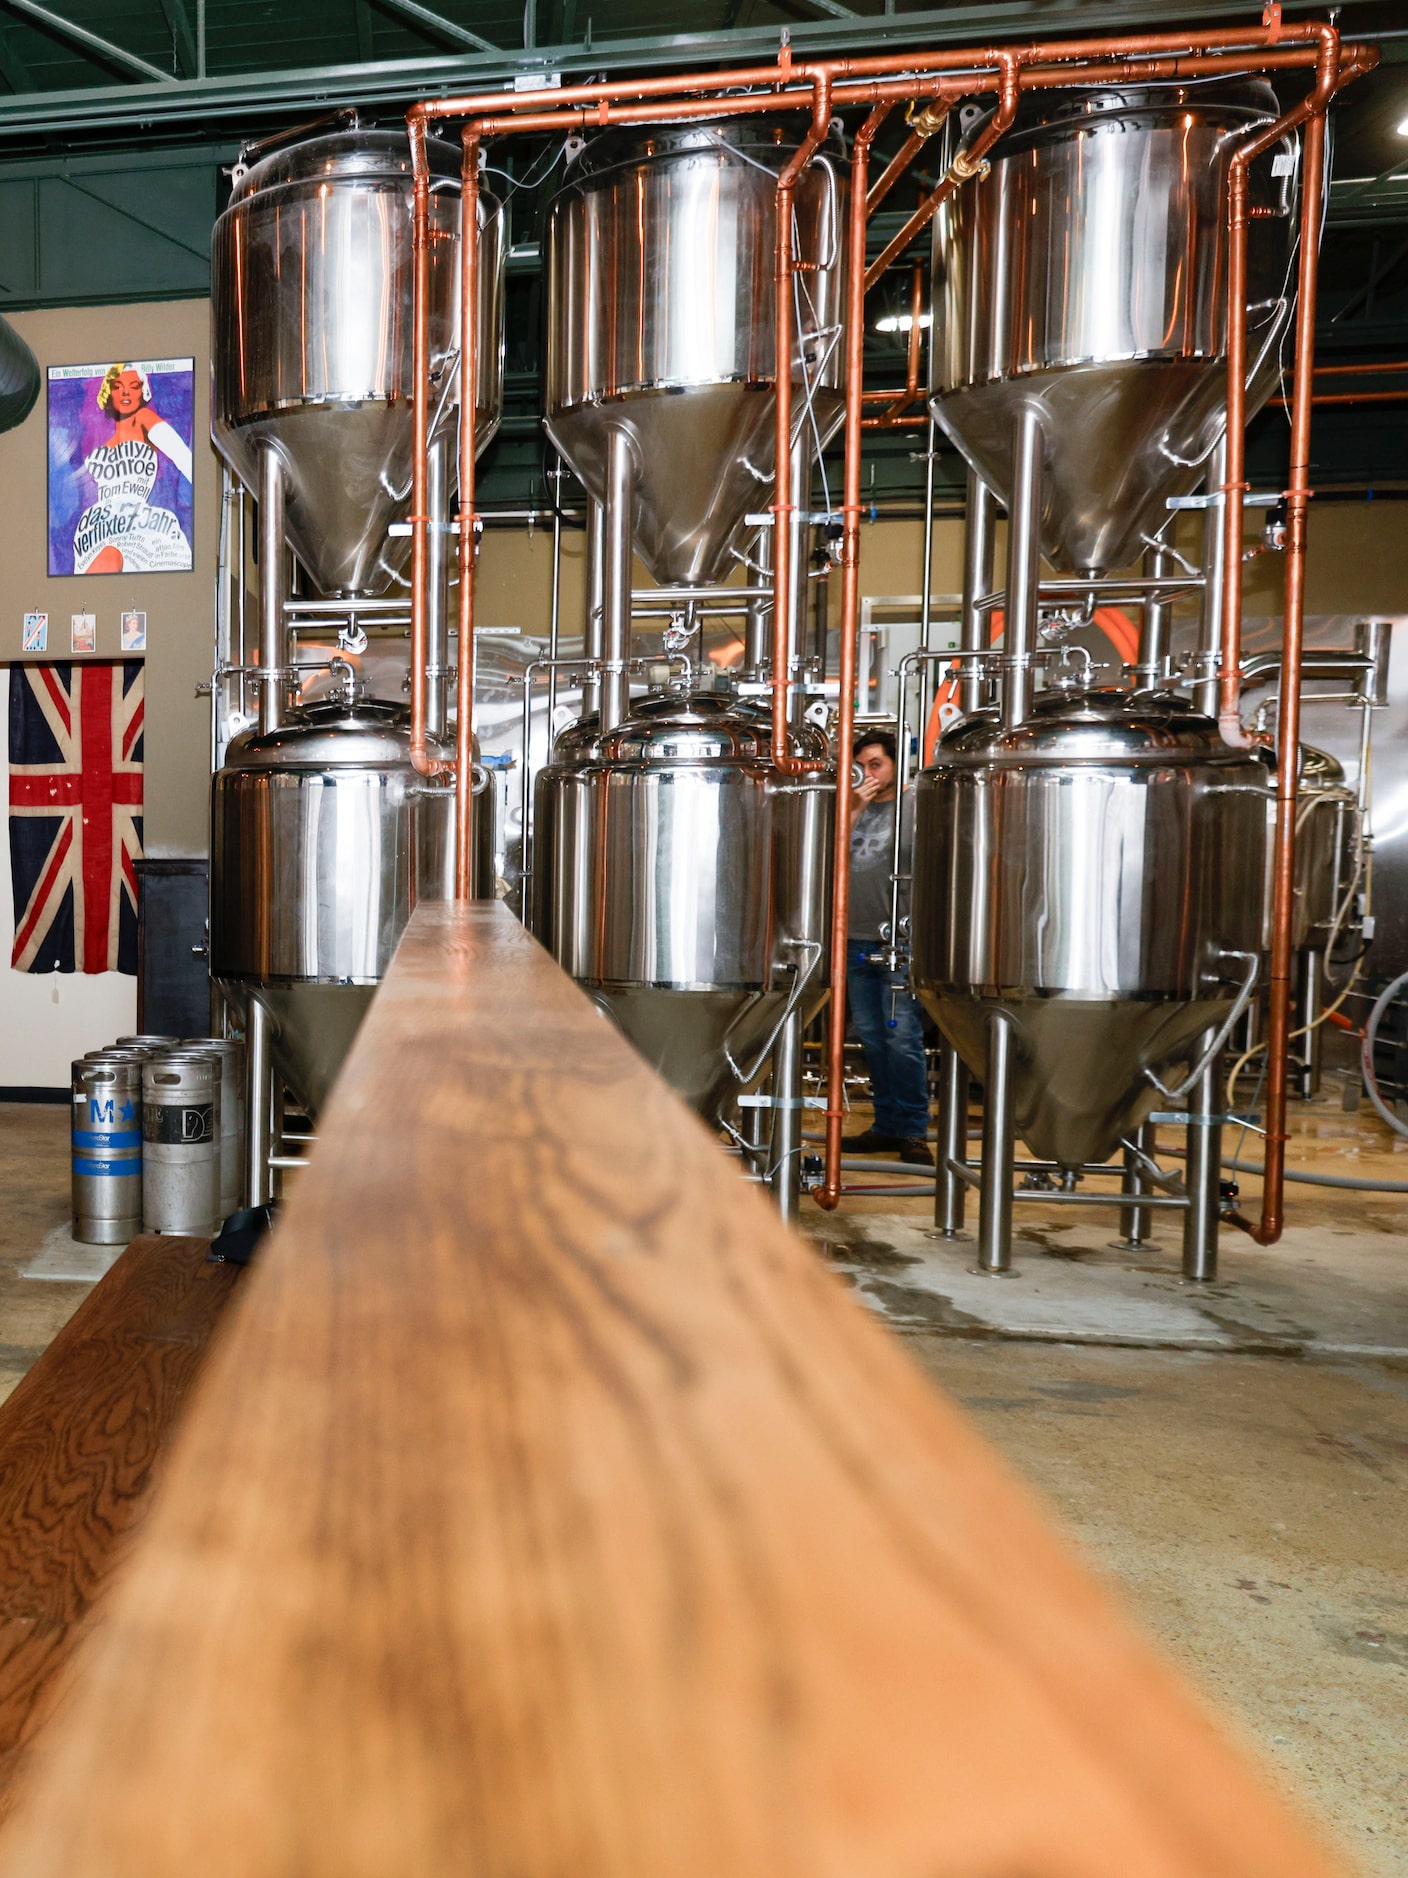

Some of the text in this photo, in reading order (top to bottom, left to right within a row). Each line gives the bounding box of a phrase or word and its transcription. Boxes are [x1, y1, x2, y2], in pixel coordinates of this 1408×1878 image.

[51, 362, 175, 378] Ein Welterfolg von Billy Wilder
[88, 440, 154, 462] marilyn
[88, 459, 156, 480] monroe
[99, 481, 150, 501] Tom Ewell
[137, 476, 150, 486] mit
[79, 504, 112, 532] das
[73, 514, 126, 557] verflixte
[138, 507, 177, 536] Jahr
[149, 559, 192, 569] Cinemascope
[90, 1099, 114, 1123] M
